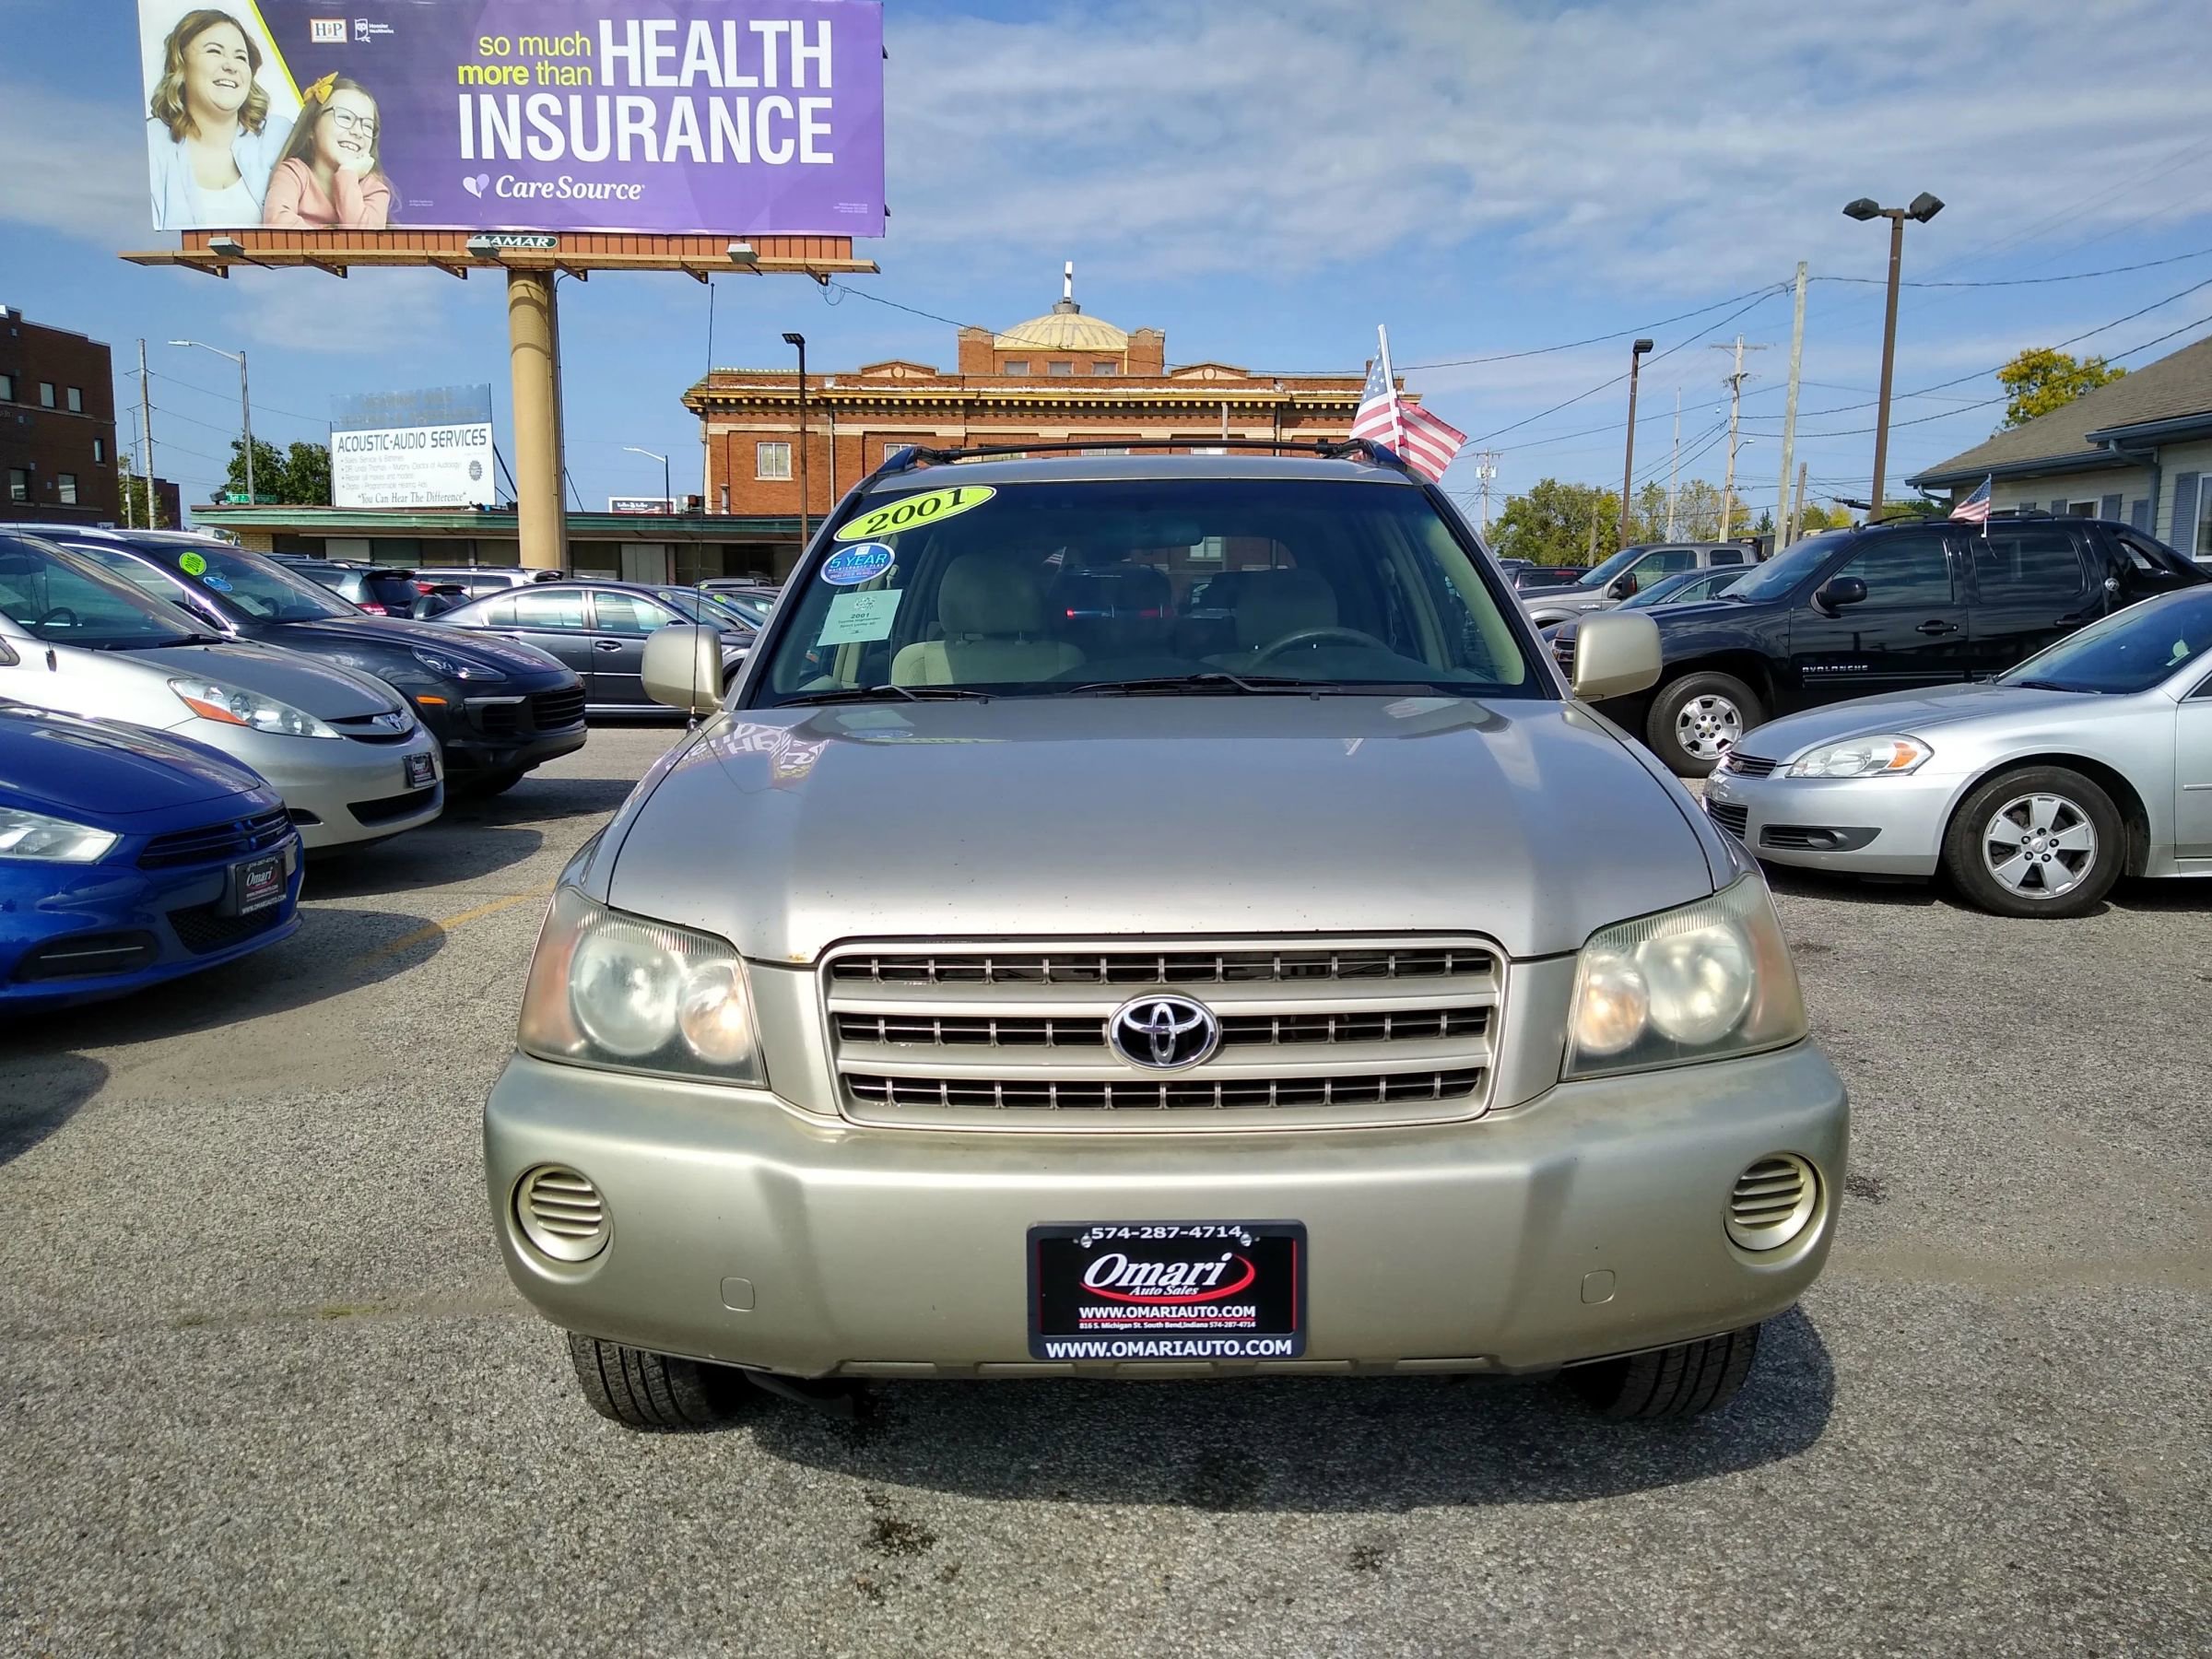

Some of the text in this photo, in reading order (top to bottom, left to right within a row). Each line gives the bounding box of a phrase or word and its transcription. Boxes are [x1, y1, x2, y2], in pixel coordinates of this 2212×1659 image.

[478, 31, 592, 56] so much
[598, 18, 832, 88] HEALTH
[457, 61, 593, 86] more than
[458, 92, 834, 164] INSURANCE
[496, 173, 643, 200] CareSource
[478, 236, 550, 247] AMAR
[430, 428, 487, 449] SERVICES
[375, 493, 389, 503] Can
[392, 492, 407, 503] Hear
[410, 491, 424, 502] The
[864, 488, 966, 535] 2001
[830, 553, 888, 569] 5 YEAR
[1802, 665, 1868, 673] AVALANCHE
[247, 866, 273, 887] Omari
[1091, 1226, 1242, 1240] 574-287-4714
[1084, 1252, 1232, 1288] Omari
[1129, 1285, 1199, 1296] Auto Sales
[1079, 1305, 1256, 1318] WWW.OMARIAUTO.COM
[1100, 1322, 1132, 1330] Michigan
[1045, 1339, 1292, 1359] WWW.OMARIAUTO.COM
